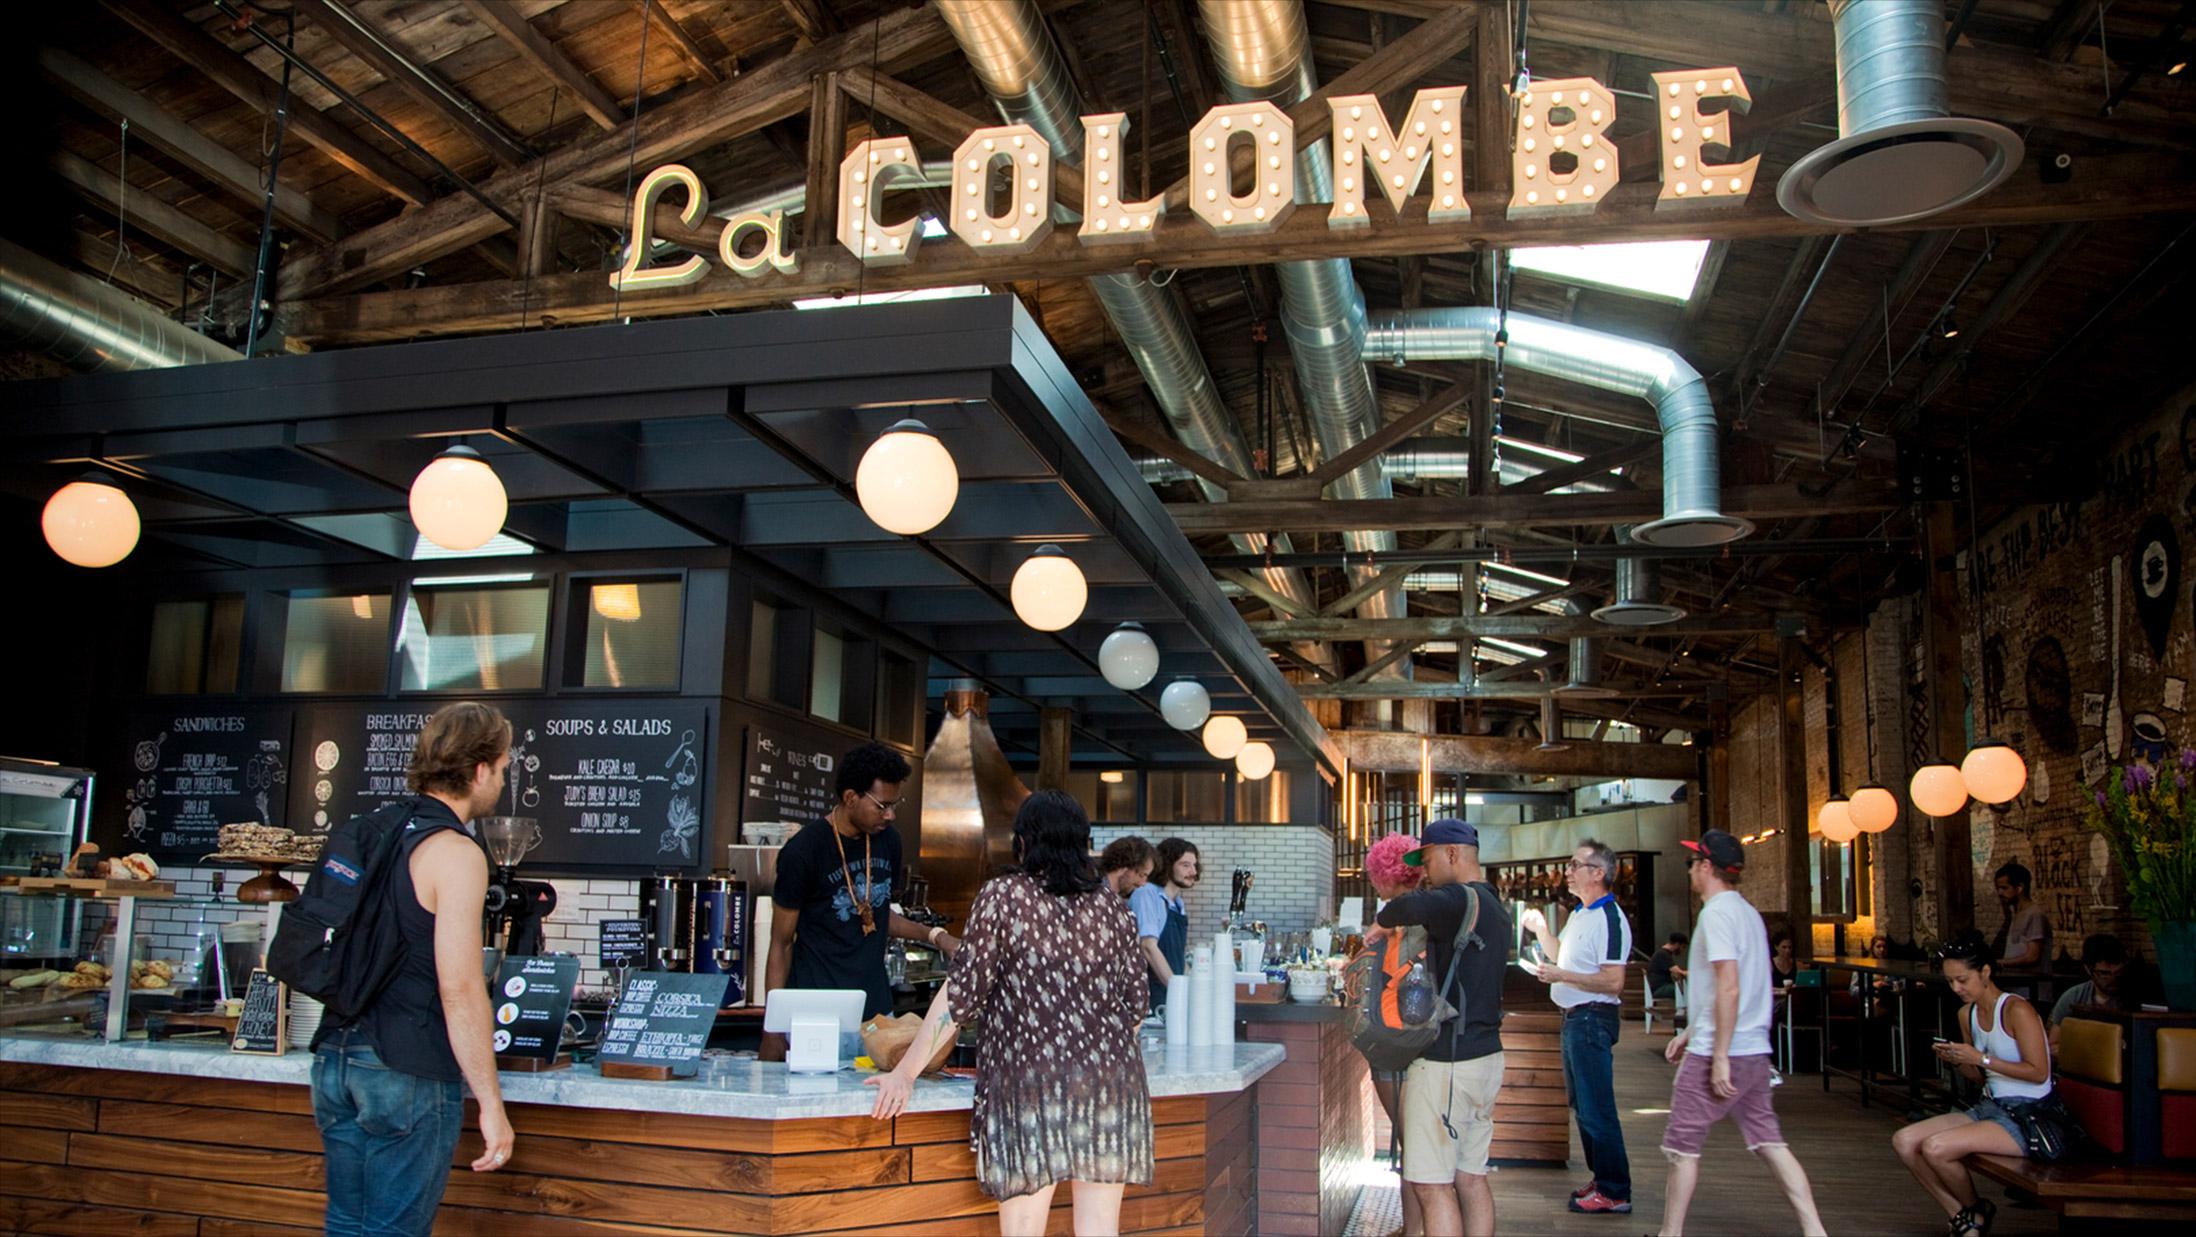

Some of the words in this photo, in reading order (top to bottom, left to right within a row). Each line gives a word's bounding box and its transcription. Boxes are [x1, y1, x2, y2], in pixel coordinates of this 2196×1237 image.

[609, 163, 801, 293] La
[835, 67, 1761, 267] COLOMBE
[173, 716, 245, 732] SANDWICHES
[366, 714, 434, 730] BREAKFAS
[546, 719, 593, 736] SOUPS
[598, 720, 608, 735] &
[612, 719, 671, 736] SALADS
[370, 733, 393, 748] SMOKED
[578, 759, 594, 775] KALE
[596, 759, 620, 775] CAESAR
[564, 785, 586, 801] JUDY'S
[587, 785, 606, 801] BREAD
[607, 785, 627, 801] SALAD
[581, 812, 600, 828] ONION
[602, 812, 617, 828] SOUP
[733, 895, 742, 934] COLOMBE
[2057, 892, 2085, 934] SEA
[655, 992, 702, 1006] CORSICA
[651, 1005, 688, 1018] NIZZA
[639, 1031, 683, 1045] ETHIOPIA
[634, 1044, 665, 1058] BRAZIL
